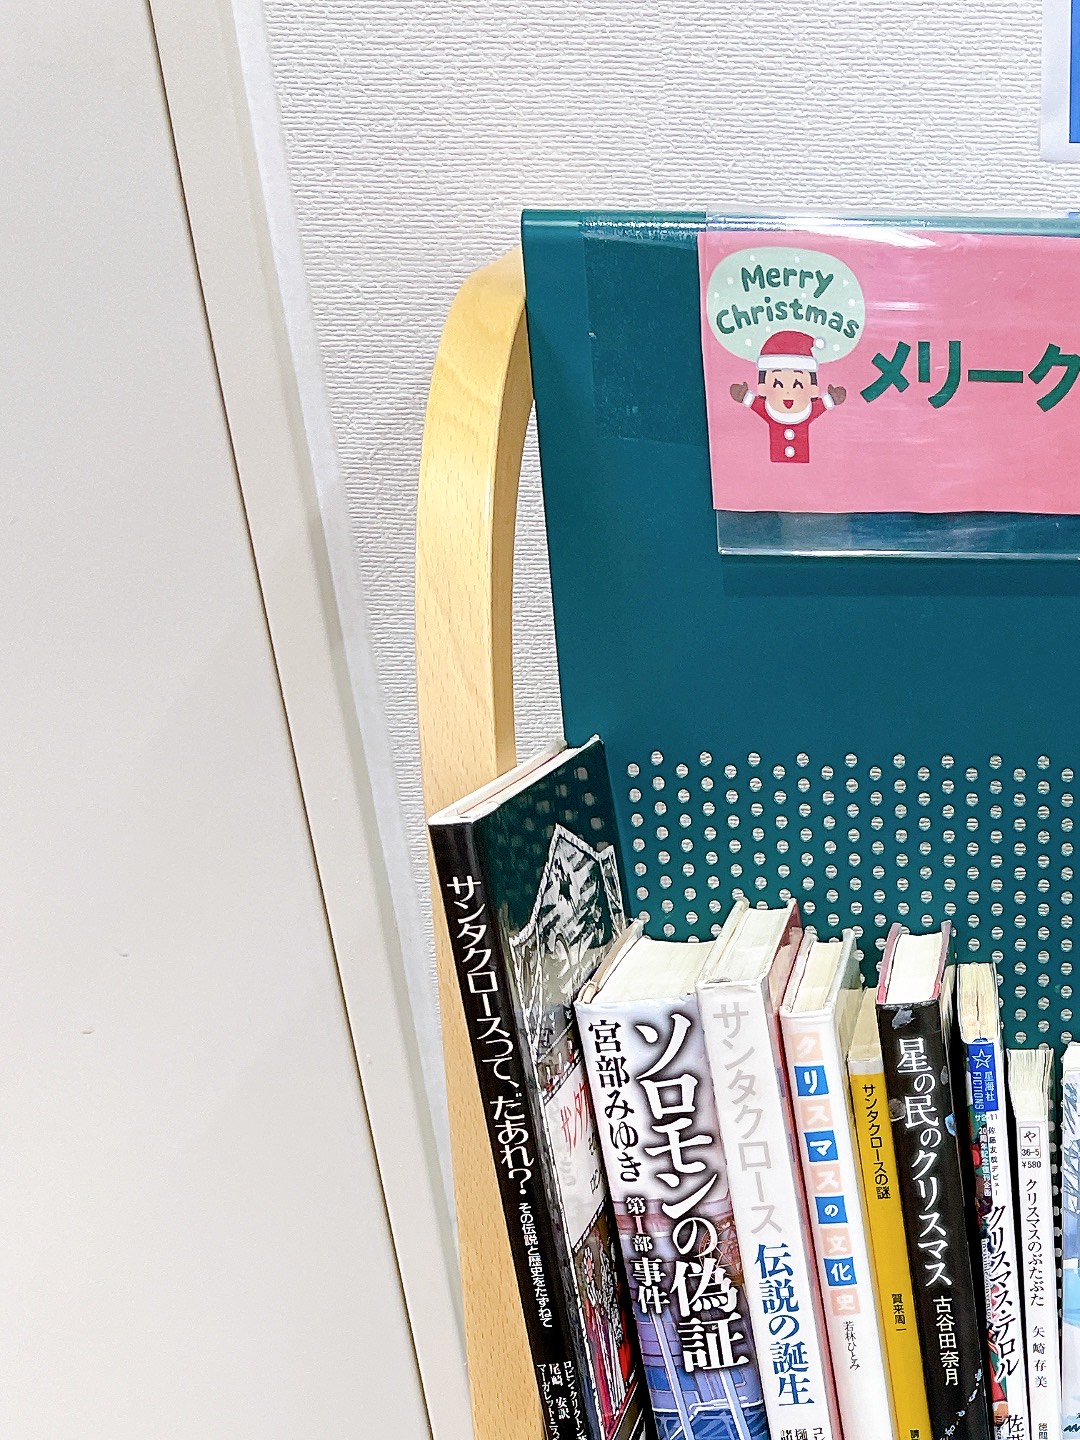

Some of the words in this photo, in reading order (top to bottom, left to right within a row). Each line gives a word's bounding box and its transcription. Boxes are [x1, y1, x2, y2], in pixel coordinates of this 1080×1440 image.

[716, 296, 860, 339] Christmas
[741, 264, 834, 299] Merry
[588, 1018, 641, 1183] 宮部みゆき
[862, 1083, 891, 1200] サンタクロースの謎
[972, 1071, 985, 1110] FICTIONS
[1023, 1130, 1037, 1143] や
[634, 1011, 749, 1374] ソロモンの偽証
[712, 1001, 783, 1236] サンタクロース
[754, 1242, 815, 1407] 伝説の誕生
[795, 1034, 860, 1313] クリスマスの文化史
[896, 1036, 953, 1288] 星の民のクリスマス
[518, 1201, 553, 1329] その伝説と歴史をたずねて
[630, 1257, 671, 1315] 事件
[987, 1205, 1020, 1382] クリスマス・テロル
[1026, 1178, 1045, 1307] クリスマスのぶたぶた
[844, 1320, 861, 1370] 若林ひとみ
[932, 1295, 960, 1386] 古谷田奈月
